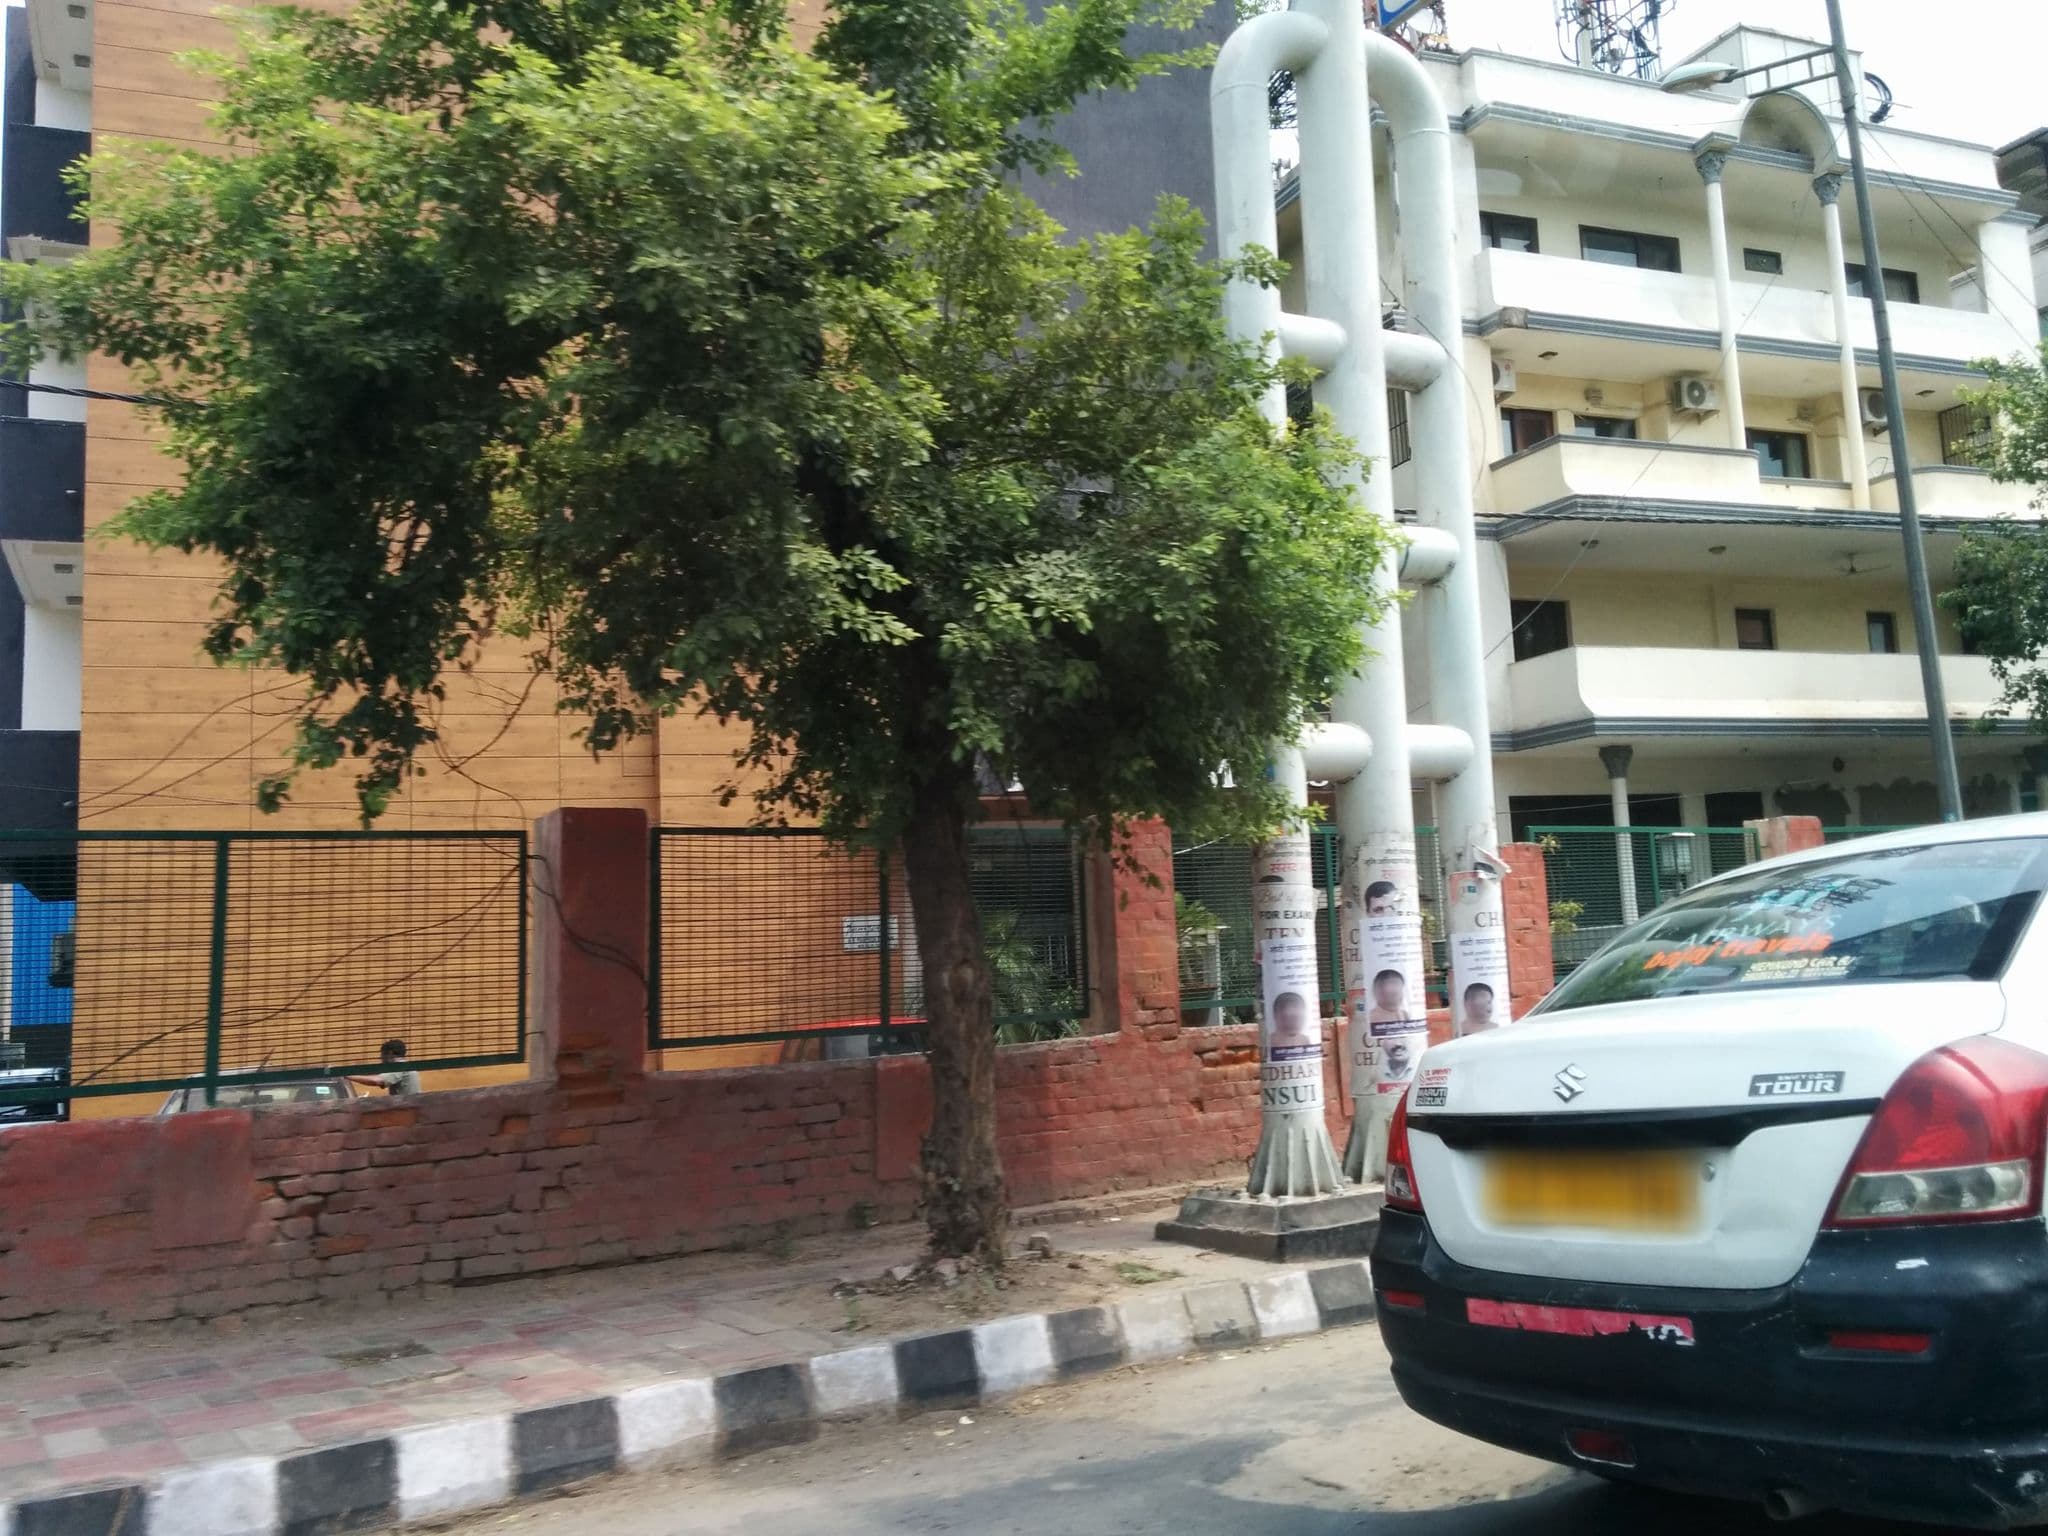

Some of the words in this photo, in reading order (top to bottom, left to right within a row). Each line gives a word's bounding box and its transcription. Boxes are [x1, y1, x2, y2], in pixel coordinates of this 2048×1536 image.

[1474, 911, 1504, 928] CH
[1263, 1084, 1317, 1106] NSUI
[1754, 1079, 1835, 1095] TOUR
